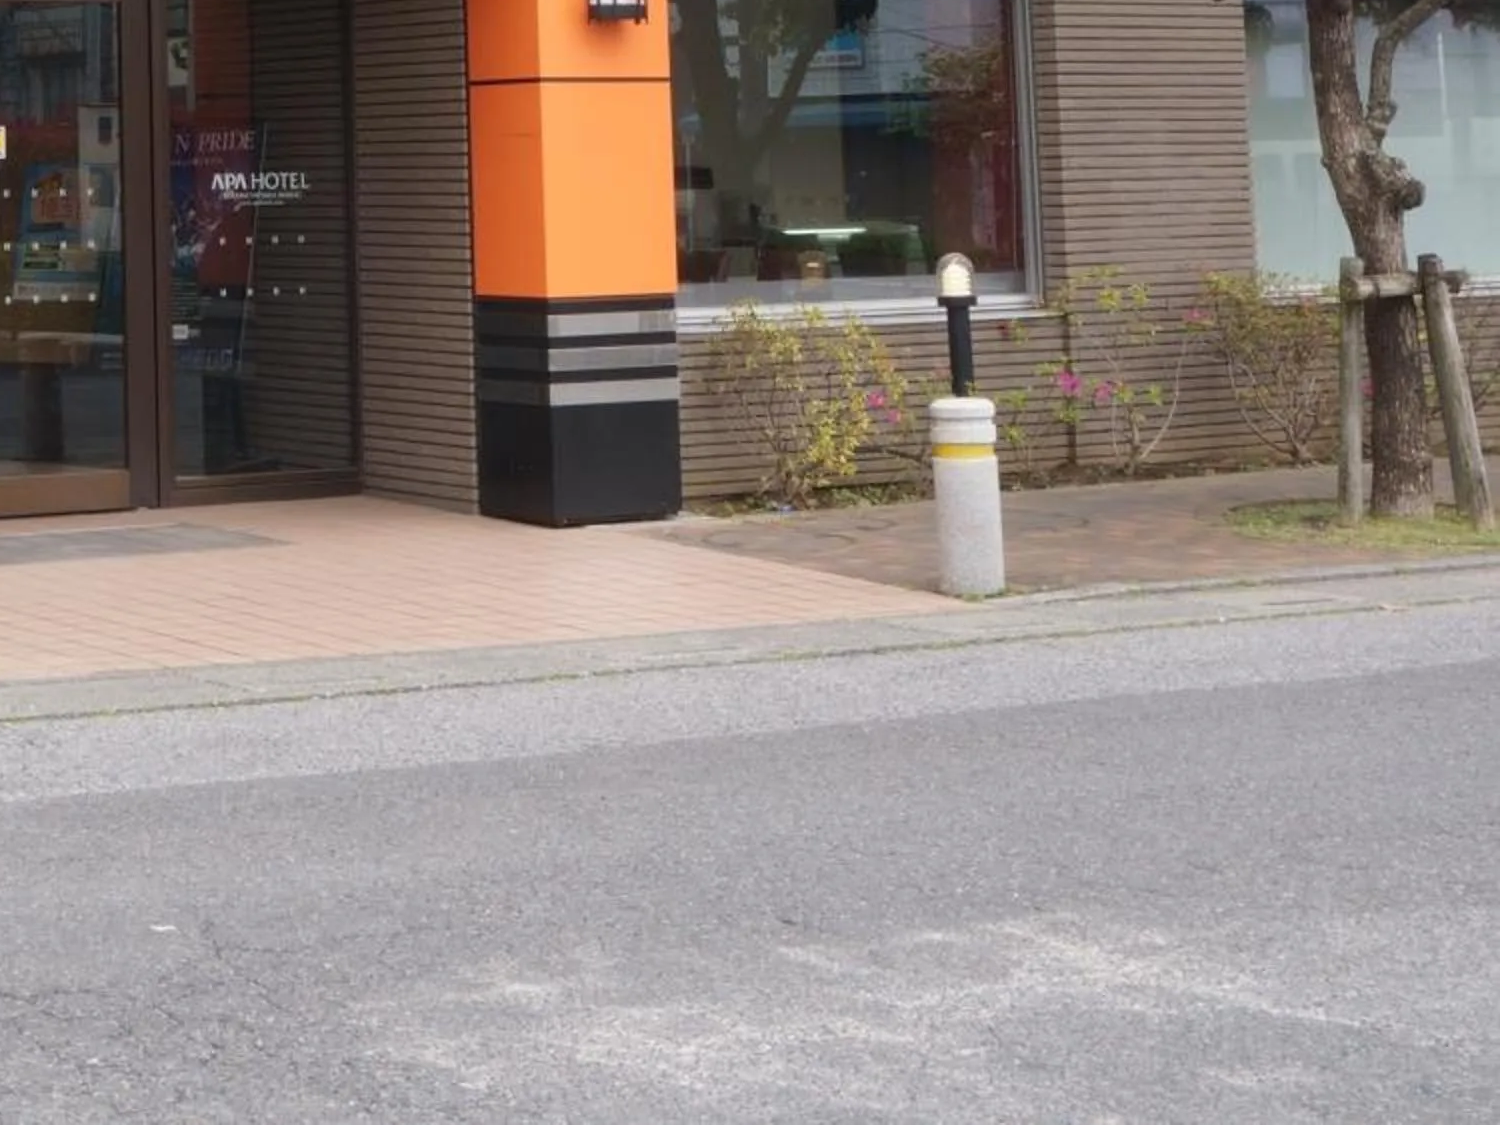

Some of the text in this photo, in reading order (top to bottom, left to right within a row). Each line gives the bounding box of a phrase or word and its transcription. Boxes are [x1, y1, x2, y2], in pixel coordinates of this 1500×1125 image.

[199, 129, 256, 152] PRIDE
[211, 172, 310, 190] APA HOTEL
